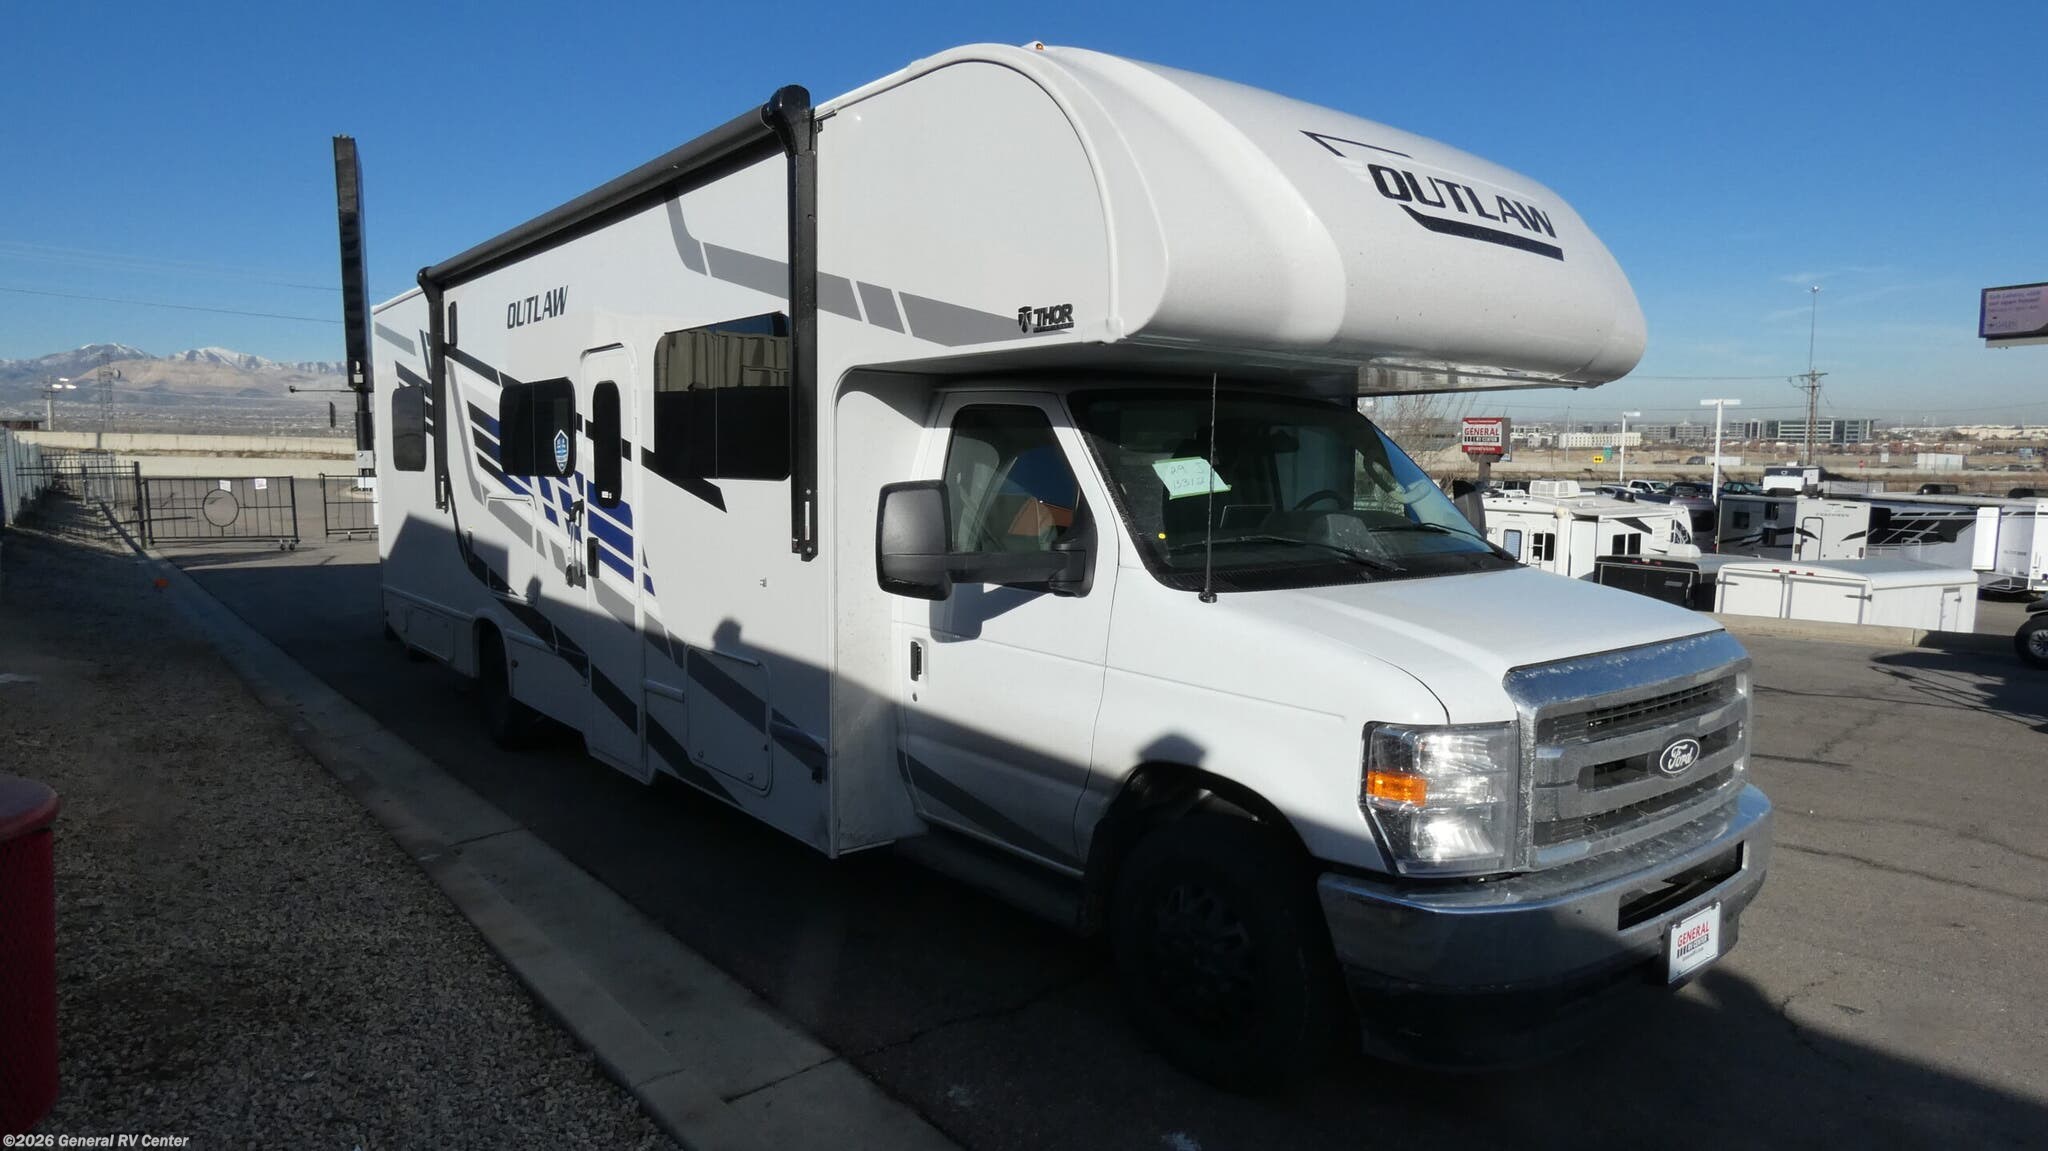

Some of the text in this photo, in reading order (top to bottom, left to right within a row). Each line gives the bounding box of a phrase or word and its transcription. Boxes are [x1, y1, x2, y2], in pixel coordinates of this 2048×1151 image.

[1367, 163, 1557, 239] OUTLAW
[507, 285, 568, 330] OUTLAW
[1033, 303, 1074, 327] THOR
[1464, 427, 1500, 436] GENERAL
[1668, 744, 1693, 770] Ford
[1677, 921, 1710, 949] GENERAL
